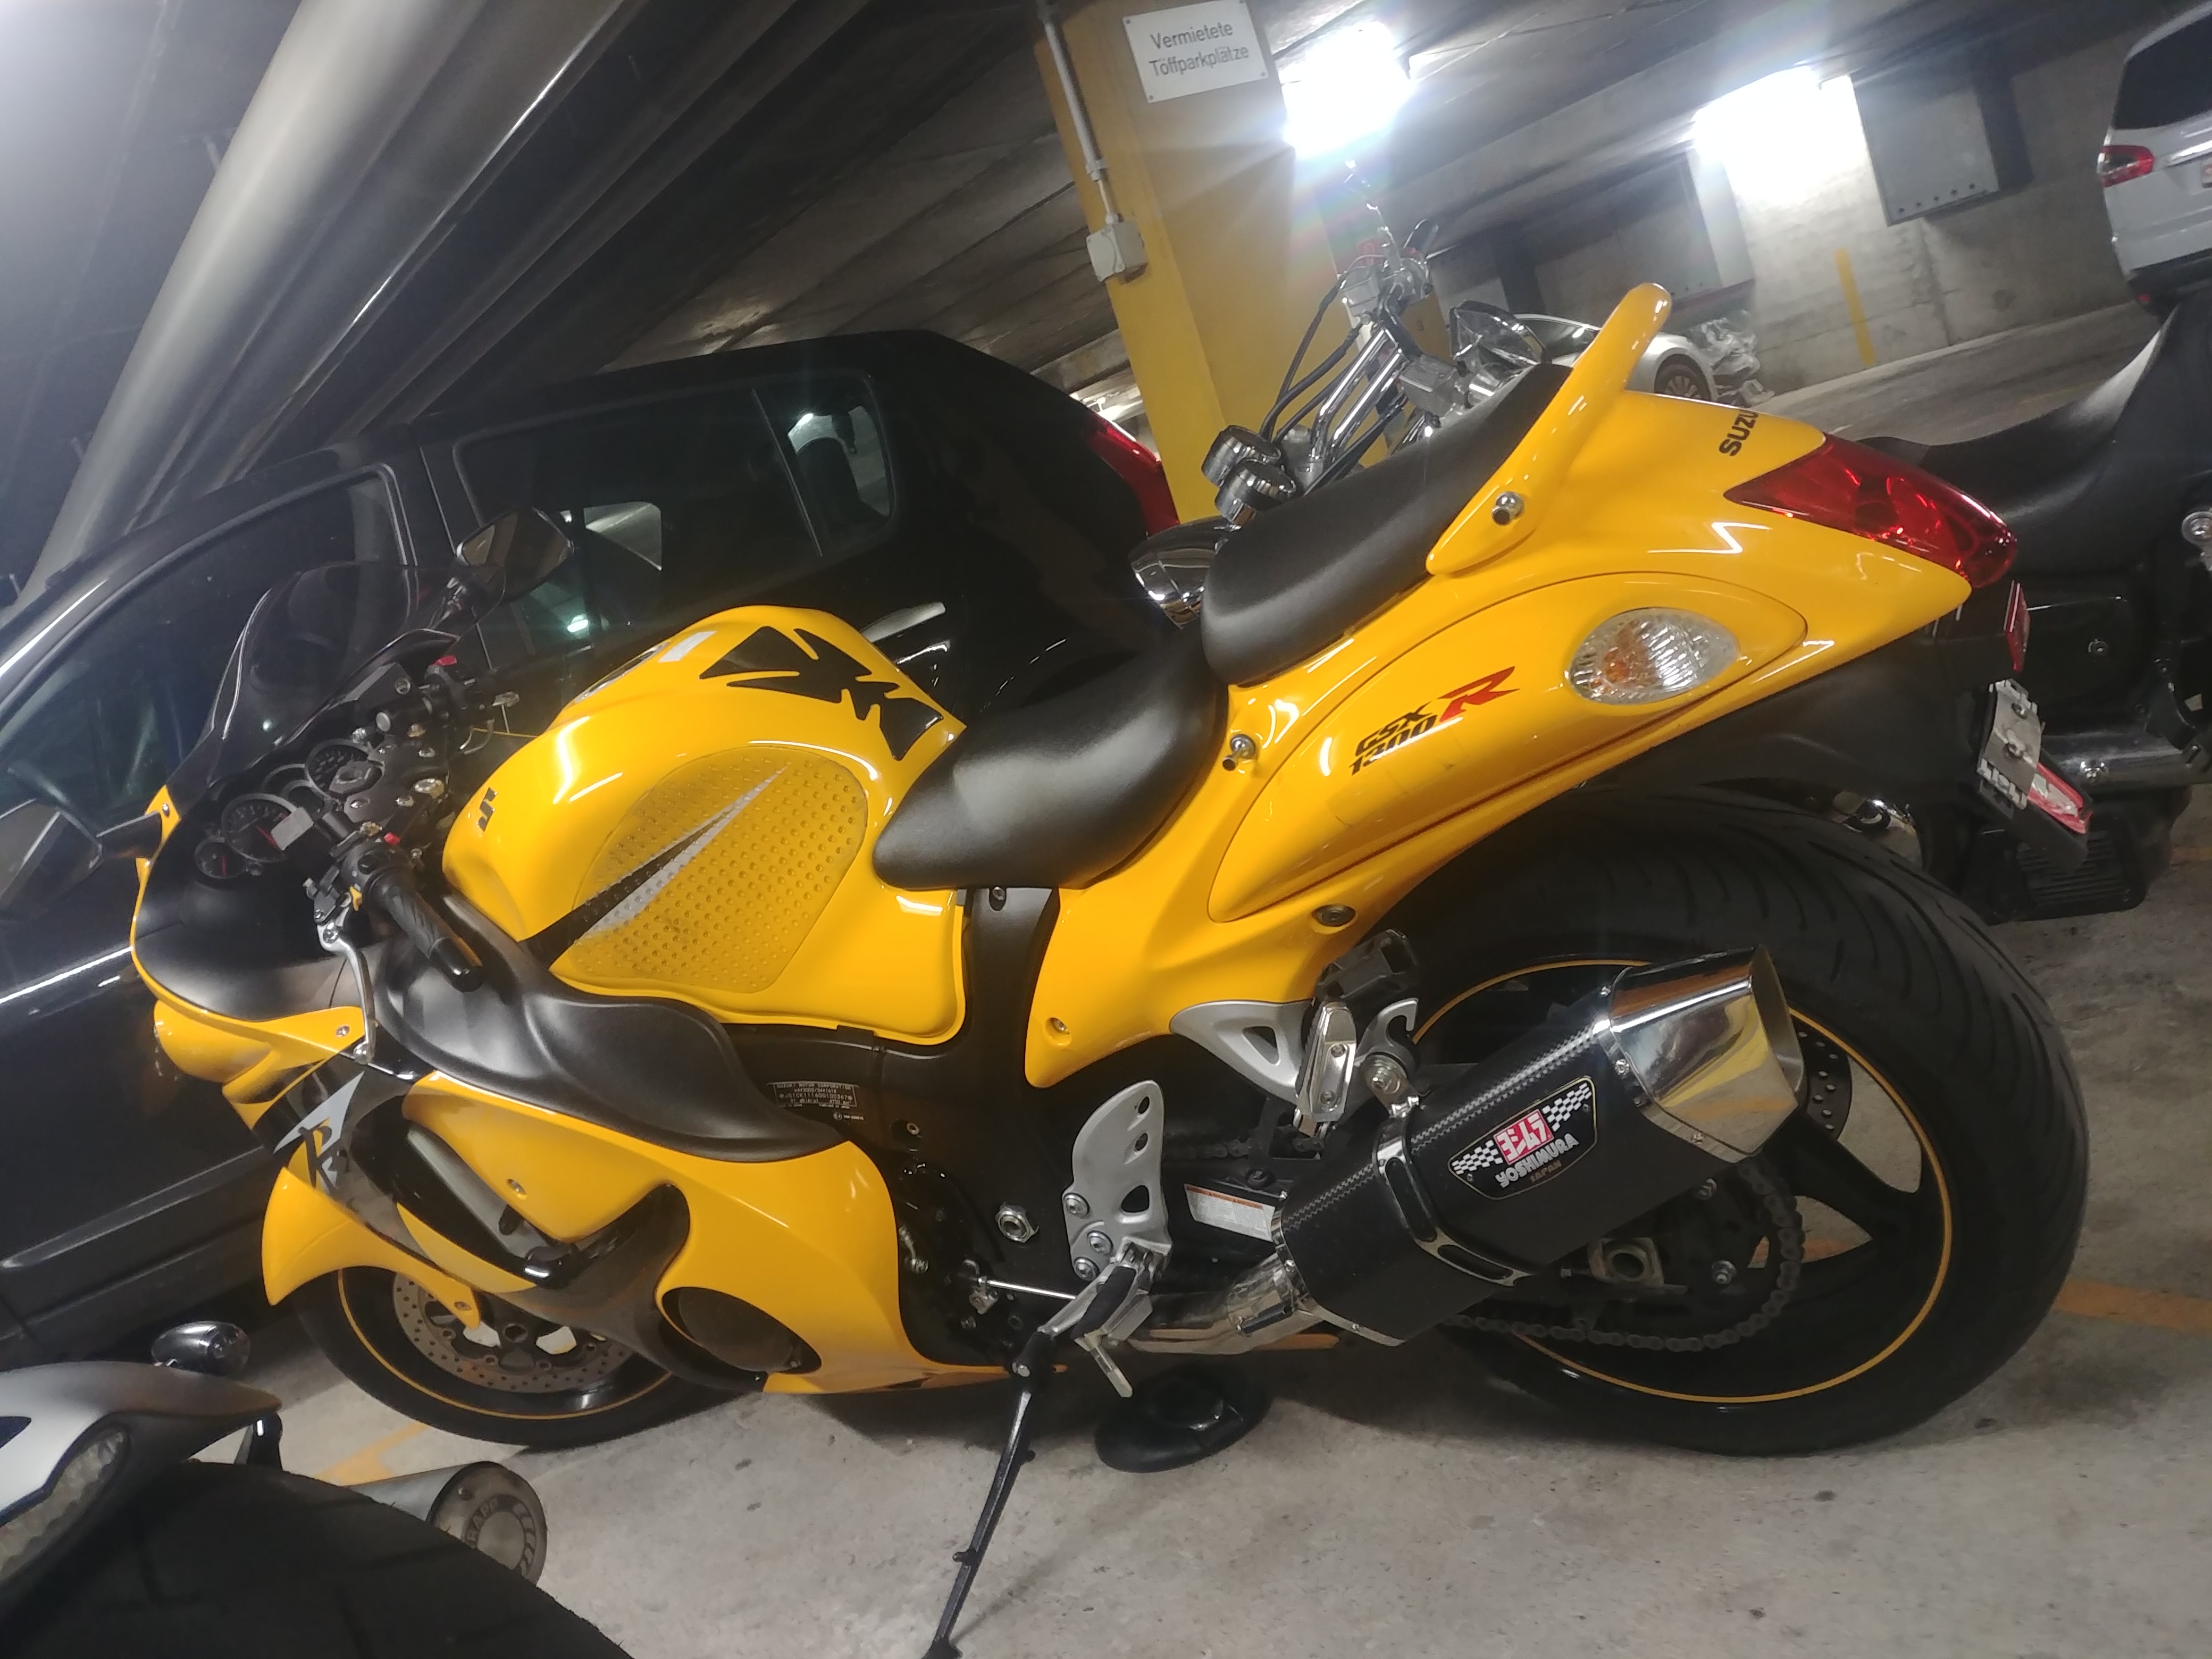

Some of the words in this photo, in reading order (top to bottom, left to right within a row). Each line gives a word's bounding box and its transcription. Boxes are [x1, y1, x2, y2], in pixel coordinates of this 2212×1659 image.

[1150, 22, 1233, 49] Vermietete
[1148, 46, 1250, 76] Töffparkplätze
[1496, 1112, 1548, 1162] ヨシムラ
[1495, 1133, 1580, 1188] YOSHIMURA
